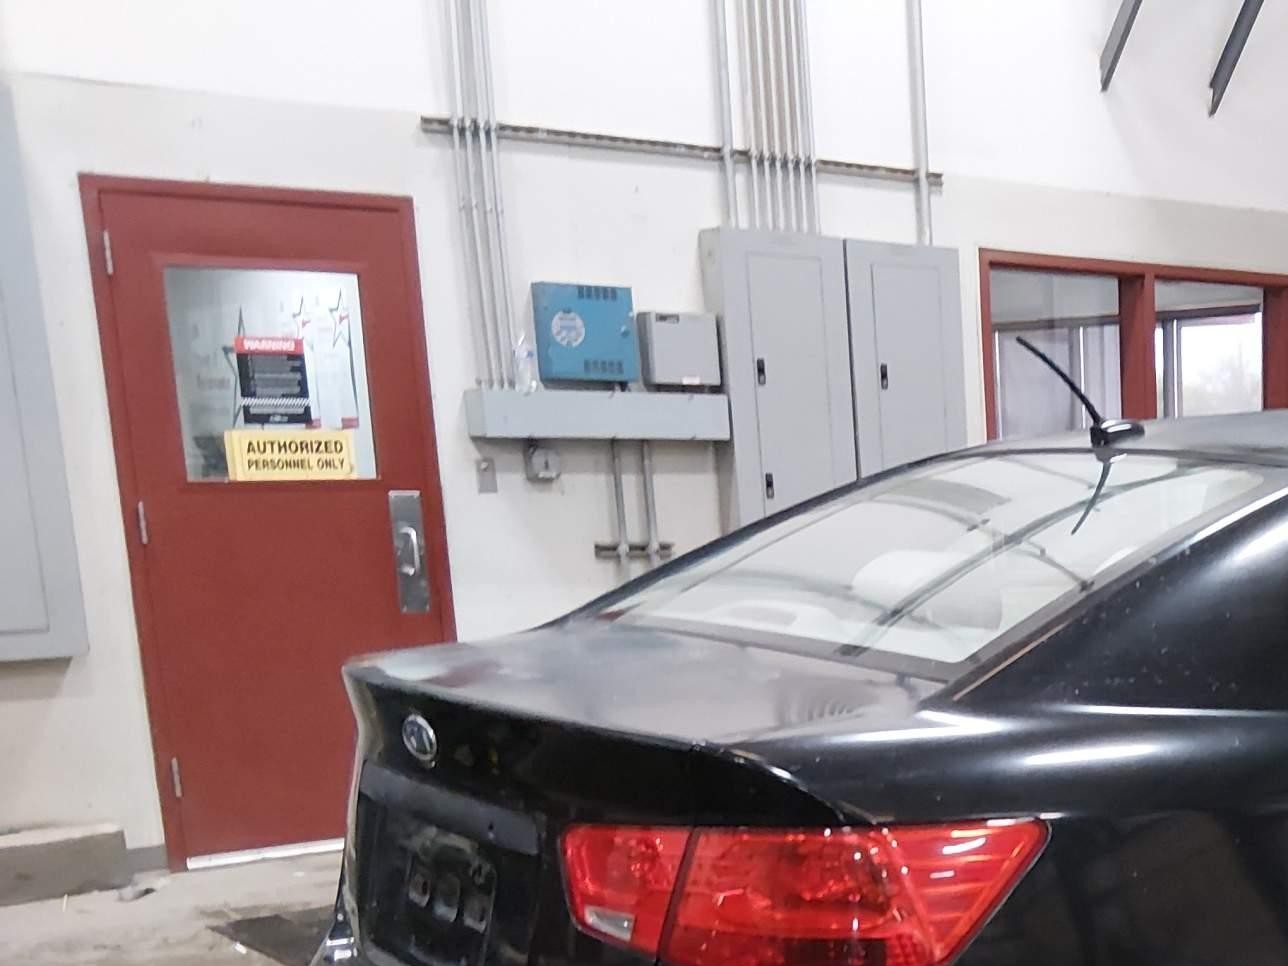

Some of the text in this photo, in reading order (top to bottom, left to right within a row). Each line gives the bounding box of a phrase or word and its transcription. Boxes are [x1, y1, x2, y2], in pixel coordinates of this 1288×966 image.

[243, 338, 296, 351] WARNING
[246, 439, 344, 455] AUTHORIZED
[247, 457, 345, 471] PERSONNEL ONLY
